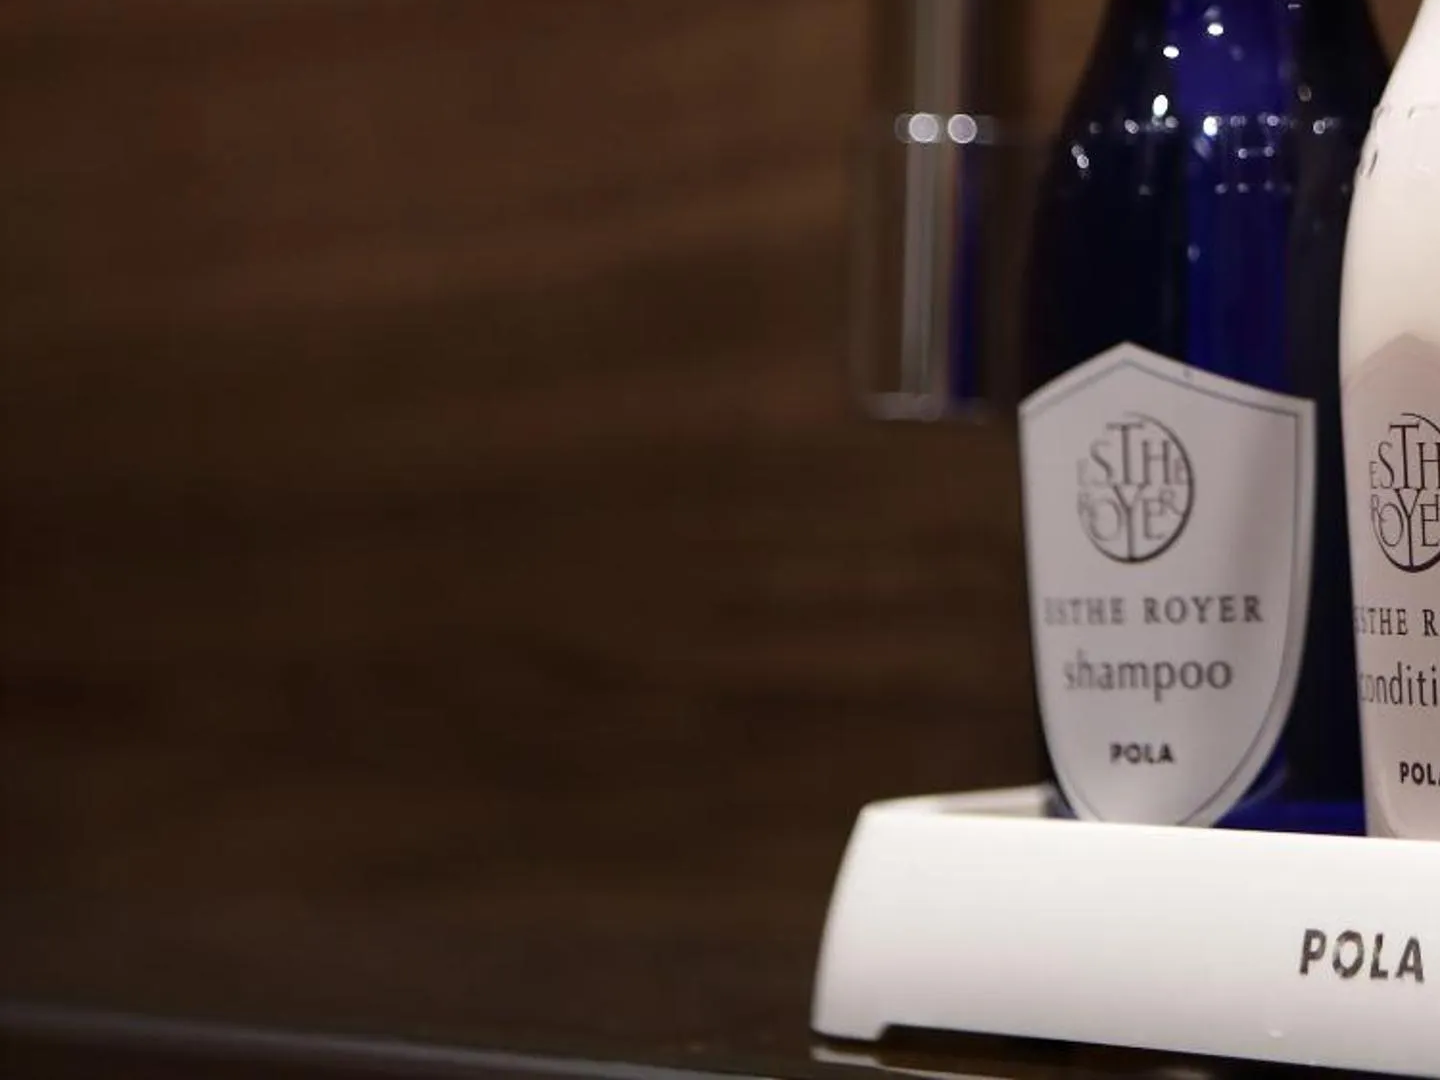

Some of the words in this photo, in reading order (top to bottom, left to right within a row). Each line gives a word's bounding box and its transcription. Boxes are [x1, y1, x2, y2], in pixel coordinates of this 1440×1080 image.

[1044, 597, 1125, 626] ESTHE
[1145, 596, 1265, 625] ROYER
[1064, 649, 1233, 703] shampoo
[1109, 741, 1176, 765] POLA
[1299, 927, 1425, 983] POLA
